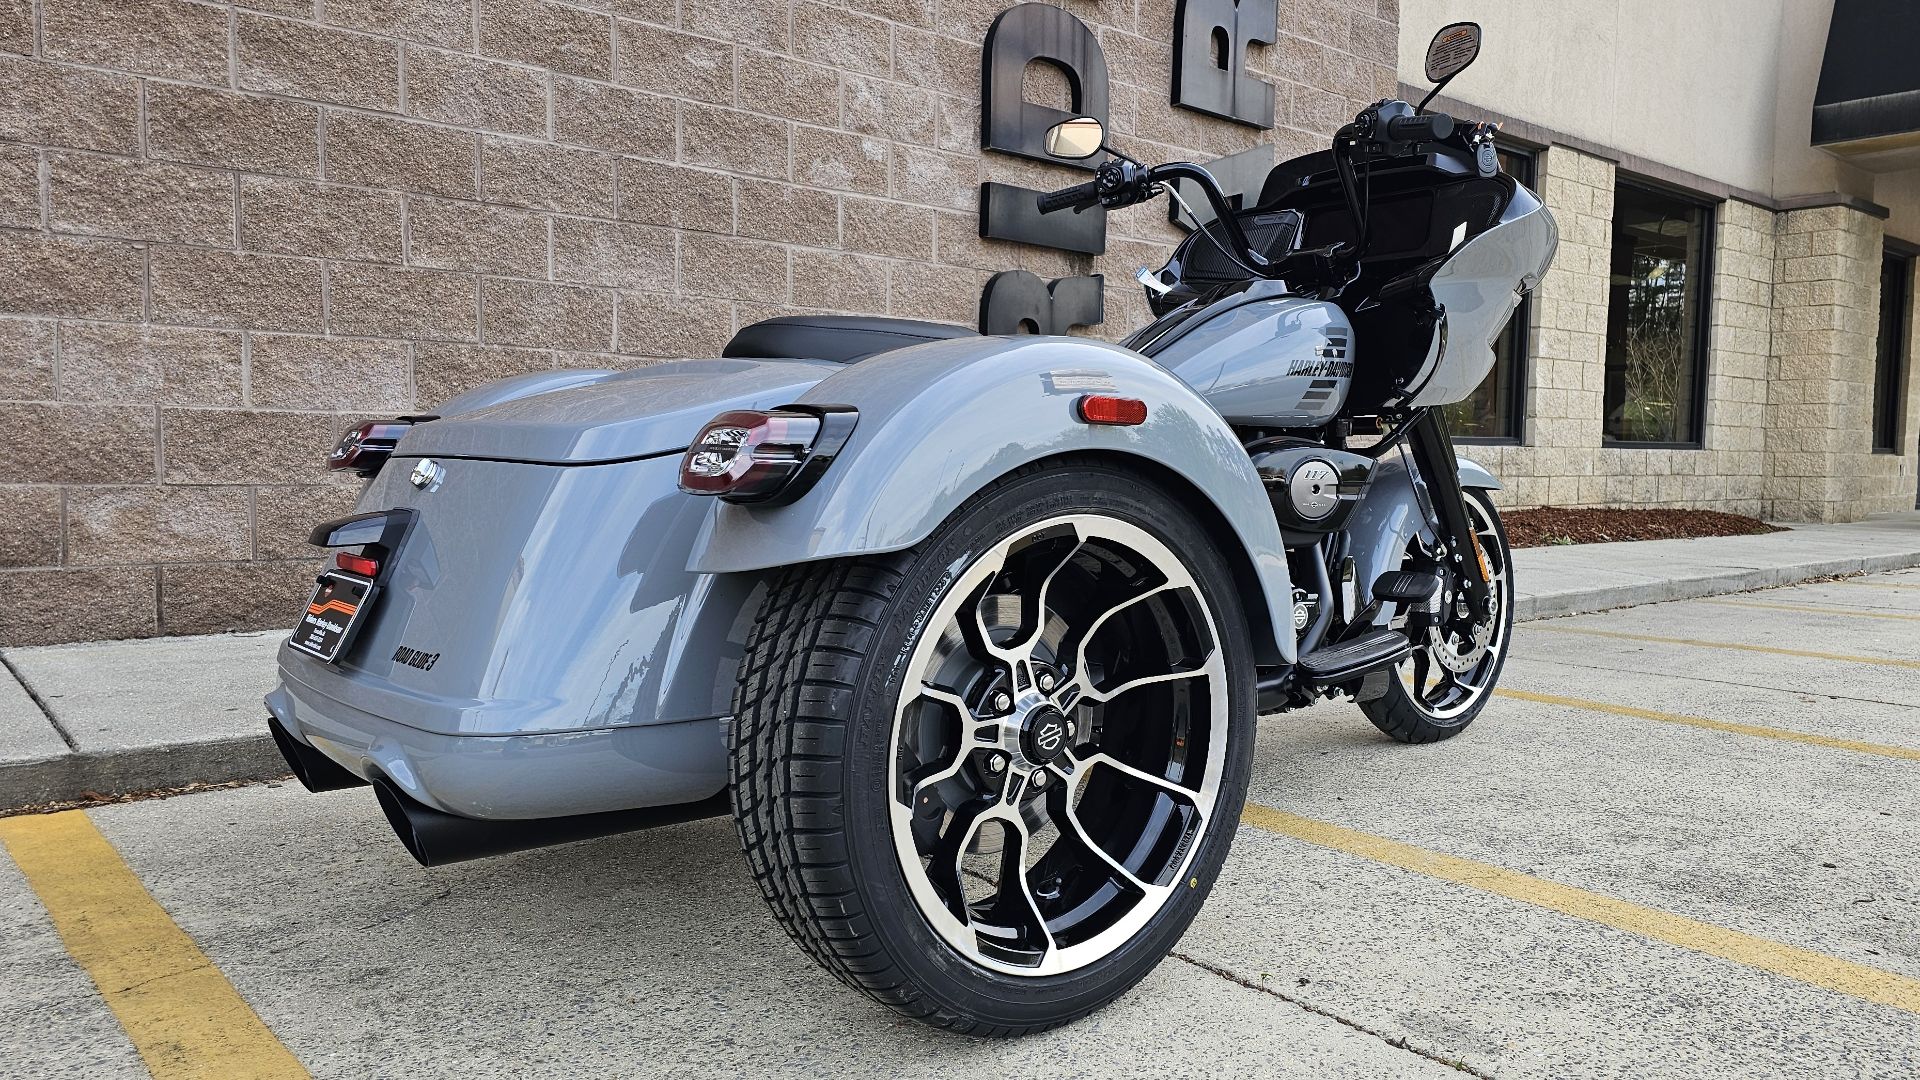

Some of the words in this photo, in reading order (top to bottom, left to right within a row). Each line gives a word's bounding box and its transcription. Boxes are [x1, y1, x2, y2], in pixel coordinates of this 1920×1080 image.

[1303, 469, 1330, 481] 117
[392, 646, 414, 665] ROAD
[408, 649, 433, 670] GLIDE
[427, 652, 441, 672] 3
